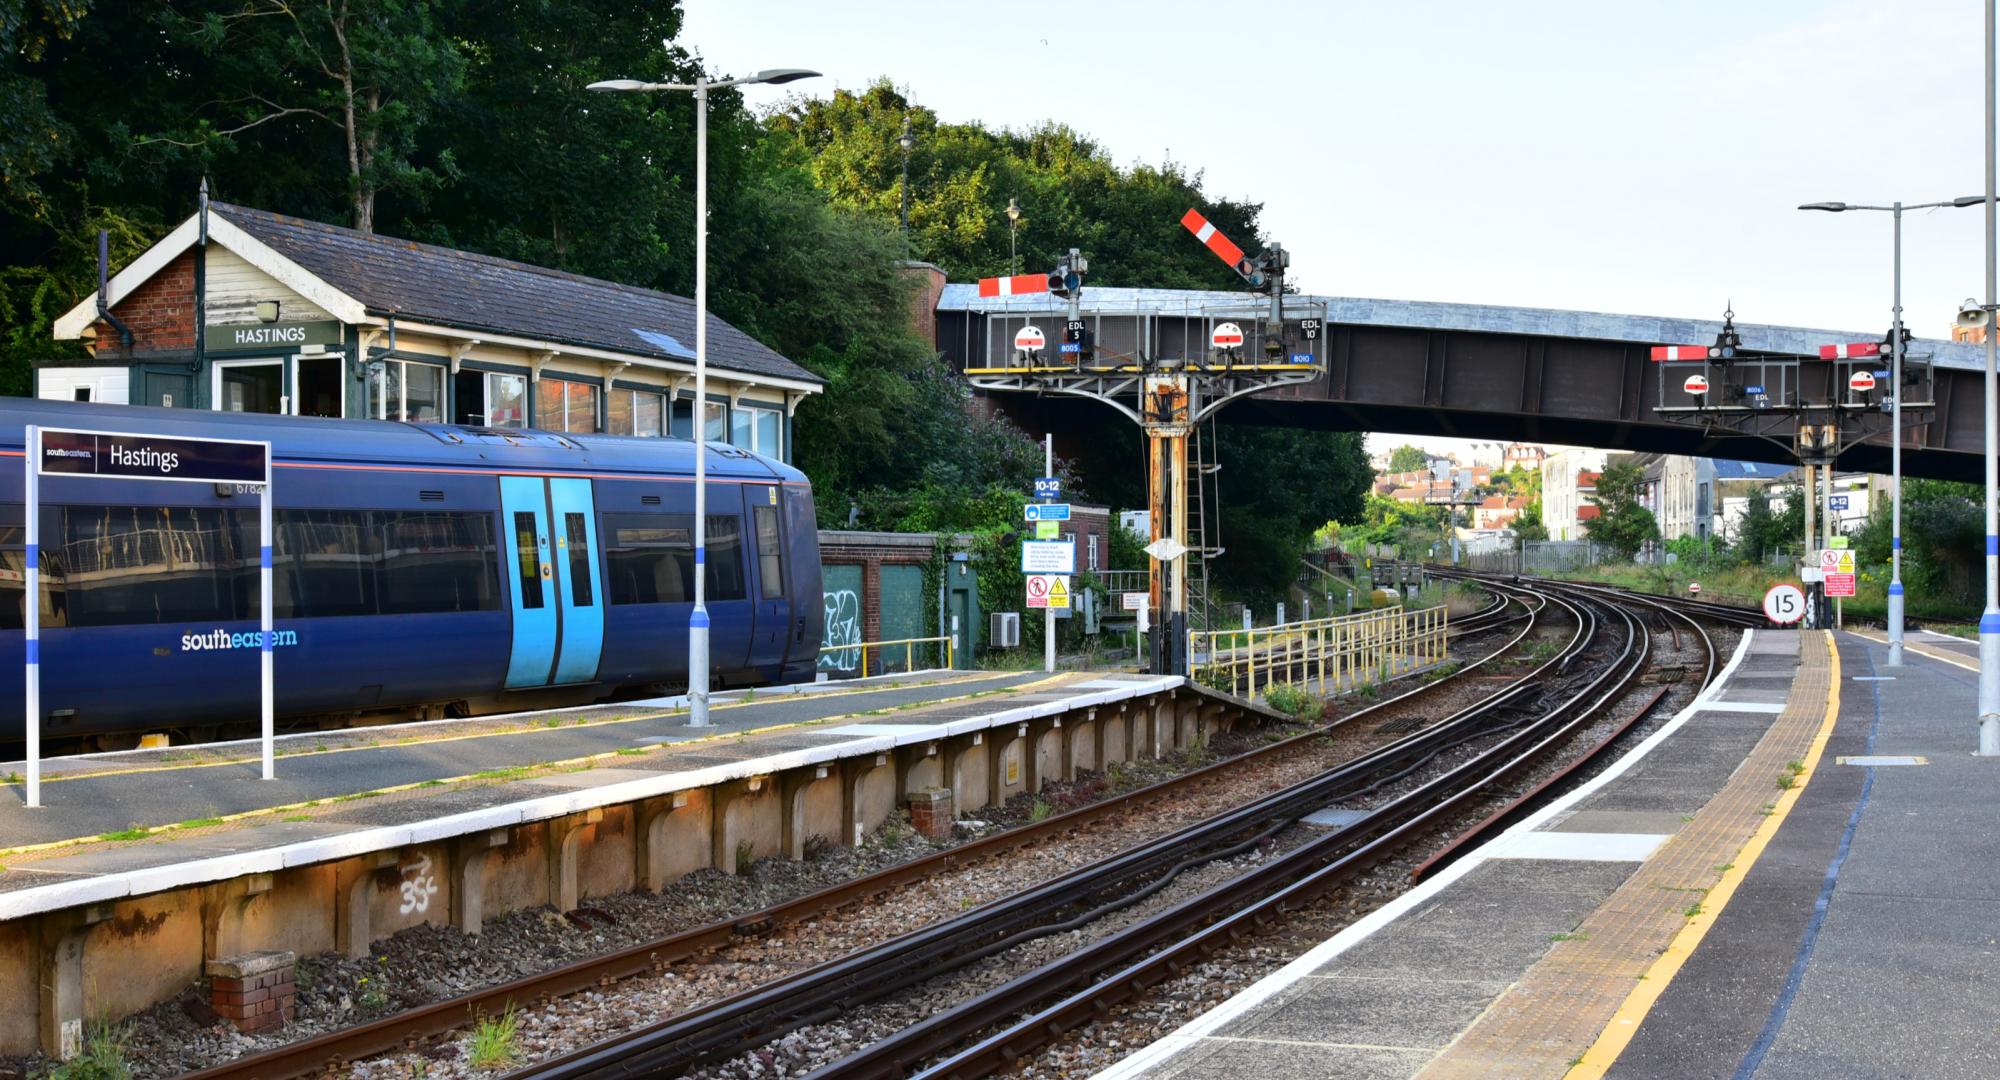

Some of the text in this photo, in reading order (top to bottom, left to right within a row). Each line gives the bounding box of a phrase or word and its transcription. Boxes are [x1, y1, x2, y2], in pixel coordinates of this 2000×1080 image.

[1068, 321, 1084, 330] EDL
[1301, 320, 1320, 329] EDL
[235, 326, 306, 344] HASTINGS
[1074, 331, 1079, 340] 5
[1307, 330, 1315, 339] 10
[1061, 344, 1078, 352] 8005
[1293, 355, 1310, 363] 8010
[110, 444, 179, 473] Hastings
[1035, 480, 1060, 491] 10-12
[1830, 497, 1847, 505] 9-12
[1775, 594, 1794, 613] 15
[181, 629, 298, 651] southeasern
